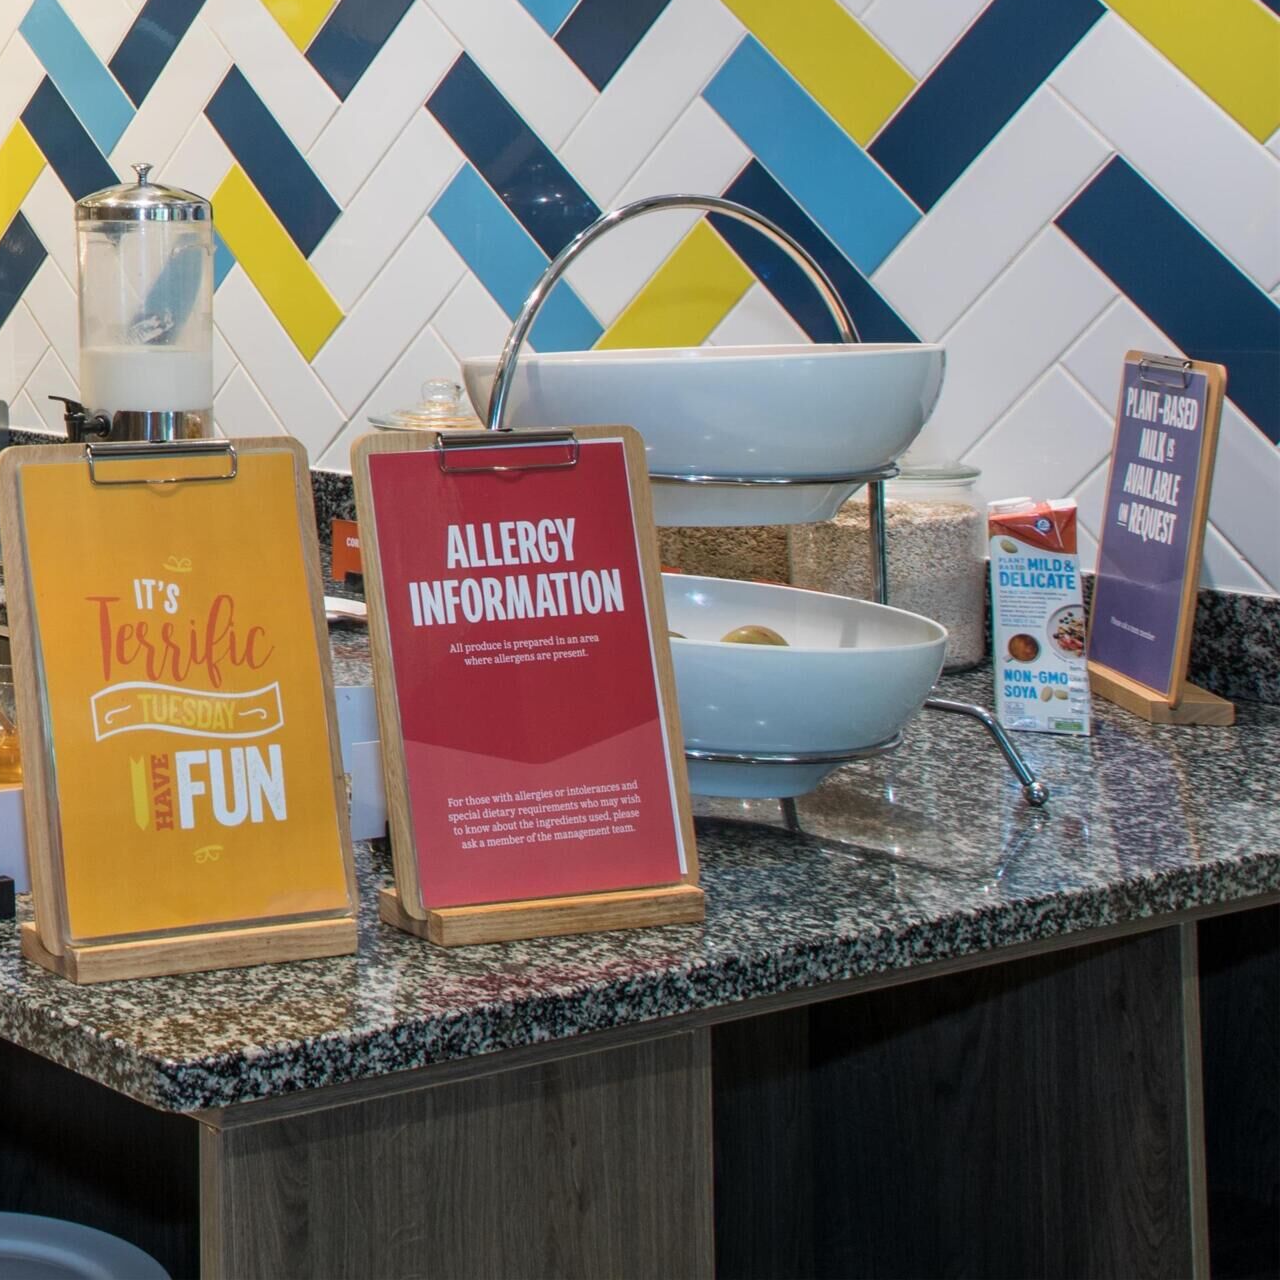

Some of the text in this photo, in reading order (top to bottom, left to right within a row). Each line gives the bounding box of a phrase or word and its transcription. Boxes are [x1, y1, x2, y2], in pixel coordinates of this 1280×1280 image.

[1125, 386, 1198, 431] PLANT-BASED
[1139, 428, 1175, 464] MILK IS
[1123, 462, 1181, 507] AVAILABLE
[1128, 502, 1177, 545] REQUEST
[447, 518, 575, 569] ALLERGY
[1000, 572, 1076, 590] DELICATE
[1028, 558, 1063, 572] MILD
[133, 578, 180, 615] IT'S
[409, 569, 625, 627] INFORMATION
[84, 594, 276, 689] Terrific
[449, 634, 599, 654] All produce is prepared in an area
[464, 648, 589, 666] where allergens are present.
[1004, 669, 1069, 685] NON-GMO
[1004, 685, 1038, 699] SOYA
[137, 693, 237, 730] TUESDAY
[151, 753, 174, 832] HAVE
[175, 744, 287, 830] FUN
[448, 780, 638, 808] For those with allergies or intolerances and
[448, 793, 641, 823] special dietary requirements who may wish
[453, 809, 640, 836] to know about the ingredients used, please
[461, 838, 478, 849] ask
[486, 834, 525, 847] member
[526, 832, 536, 843] of
[537, 831, 552, 842] the
[554, 827, 611, 841] management
[611, 824, 636, 835] team.
